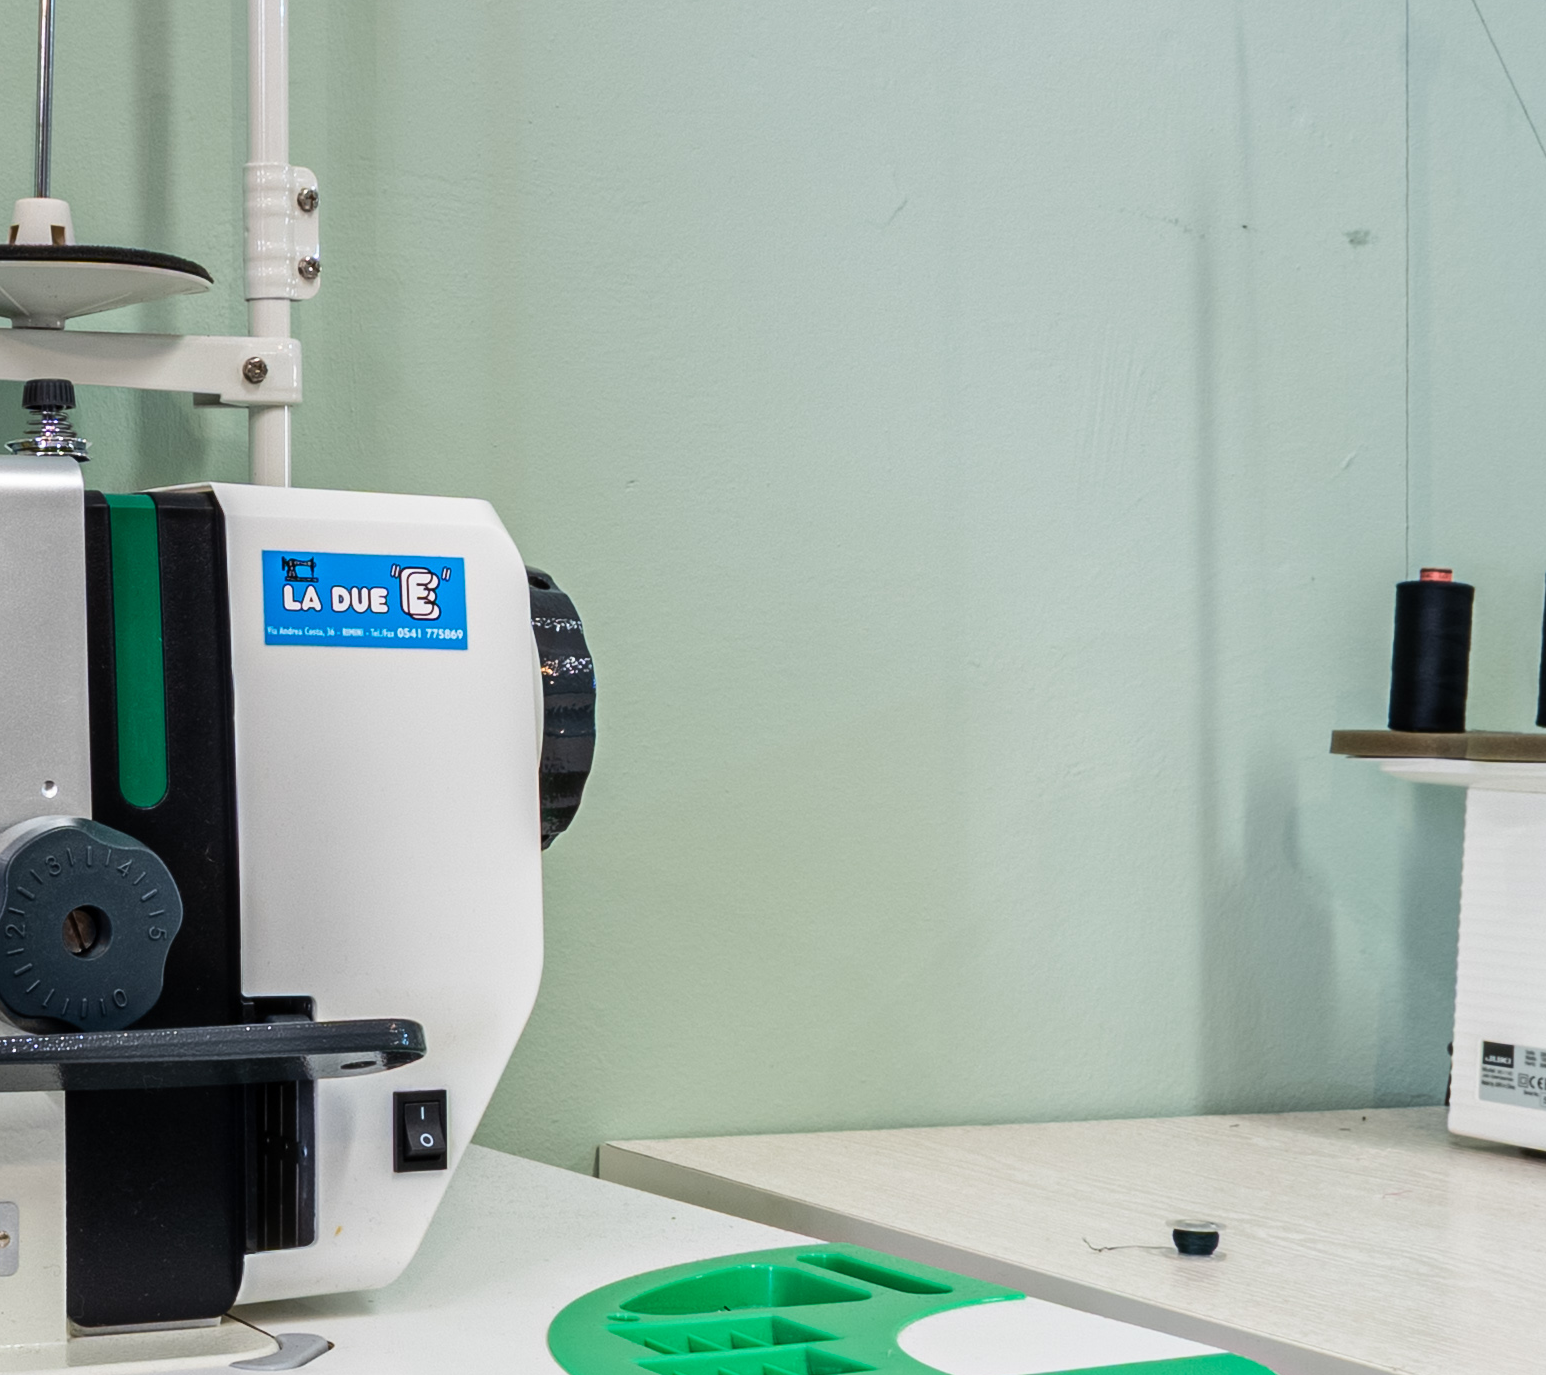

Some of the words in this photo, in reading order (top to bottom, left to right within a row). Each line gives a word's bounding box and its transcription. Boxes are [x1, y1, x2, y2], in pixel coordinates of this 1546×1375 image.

[283, 584, 322, 611] LA
[331, 585, 389, 613] DUE
[267, 627, 278, 635] Via
[279, 627, 302, 636] Andrea
[304, 627, 325, 637] Costa,
[327, 627, 335, 637] 36
[397, 628, 422, 639] 0541
[425, 628, 464, 640] 775869
[45, 855, 62, 875] 3
[117, 859, 133, 877] 4
[5, 924, 26, 938] 2
[148, 926, 167, 941] 5
[1485, 1055, 1512, 1065] JUKI
